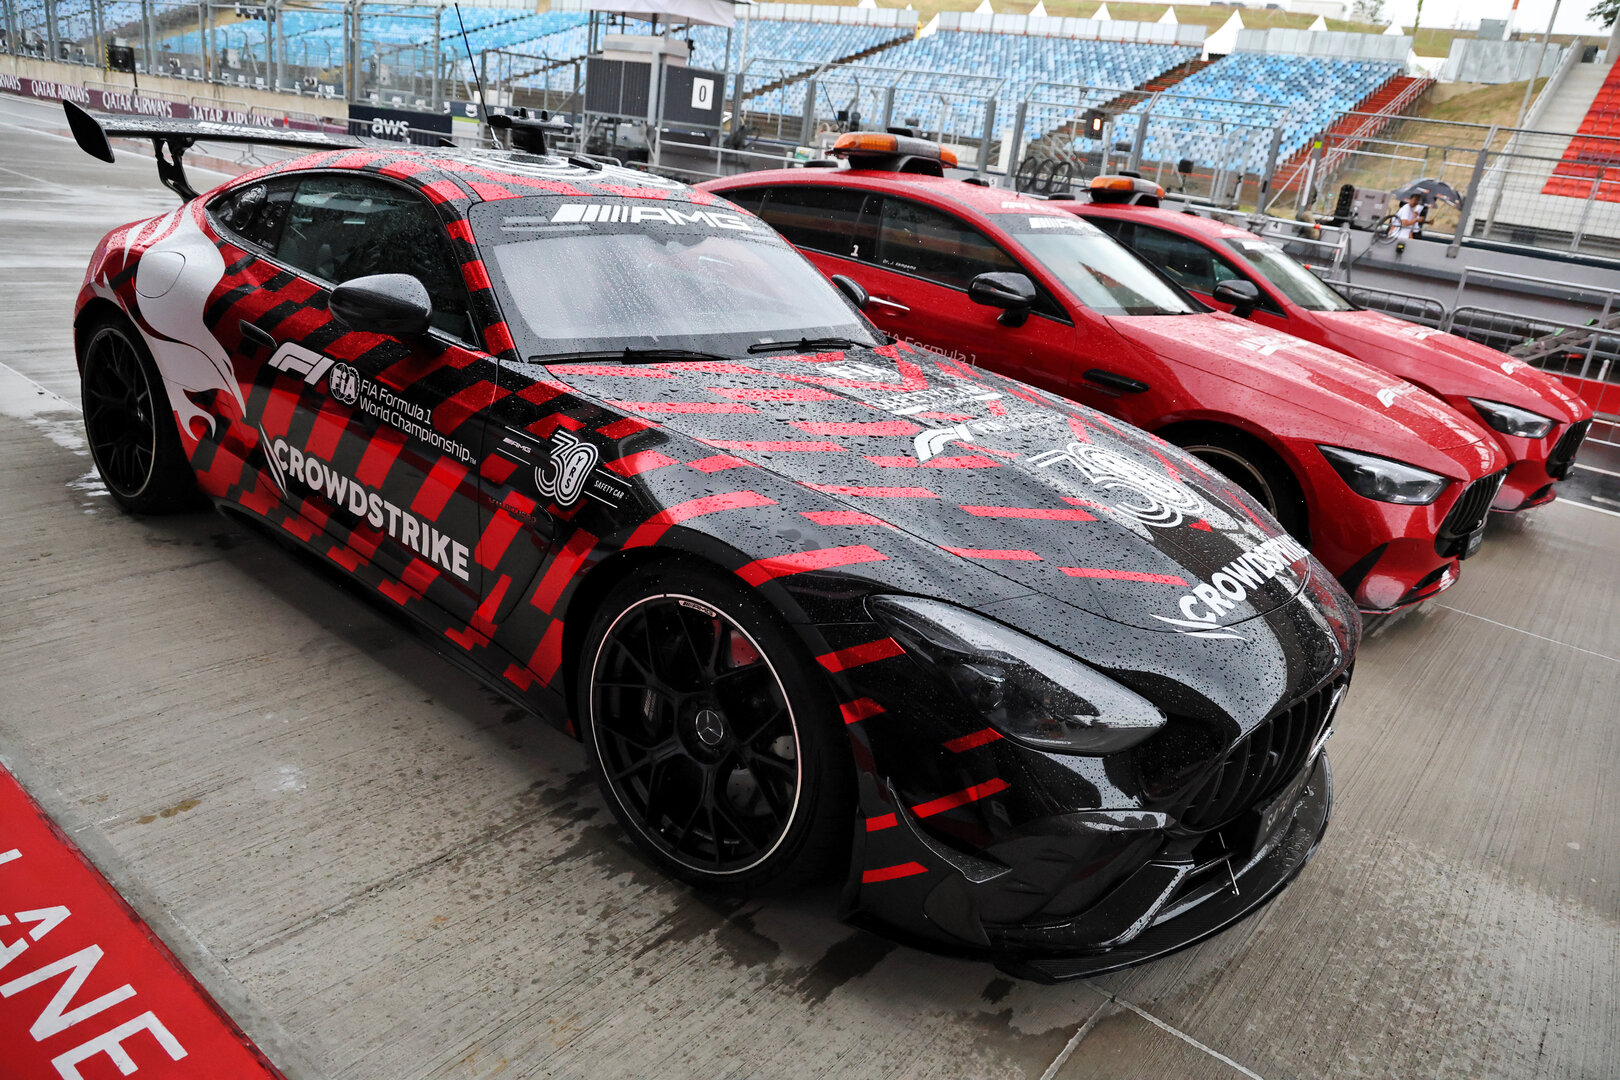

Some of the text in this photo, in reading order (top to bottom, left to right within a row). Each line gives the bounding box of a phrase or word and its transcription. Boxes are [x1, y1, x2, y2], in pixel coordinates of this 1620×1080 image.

[31, 80, 90, 104] QATAR AIRWAYS
[102, 91, 172, 118] QATAR AIRWAYS
[699, 85, 706, 102] 0
[372, 117, 409, 137] aws
[850, 244, 859, 257] 1
[267, 341, 335, 386] F1
[905, 336, 967, 363] Formula
[360, 395, 390, 423] World
[361, 379, 432, 425] FIA Formula 1
[913, 423, 975, 463] F1
[534, 429, 599, 506] 30
[563, 455, 585, 489] YRS
[594, 480, 625, 500] SAFETY CAR
[273, 438, 470, 582] CROWDSTRIKE
[0, 848, 189, 1080] ANE
